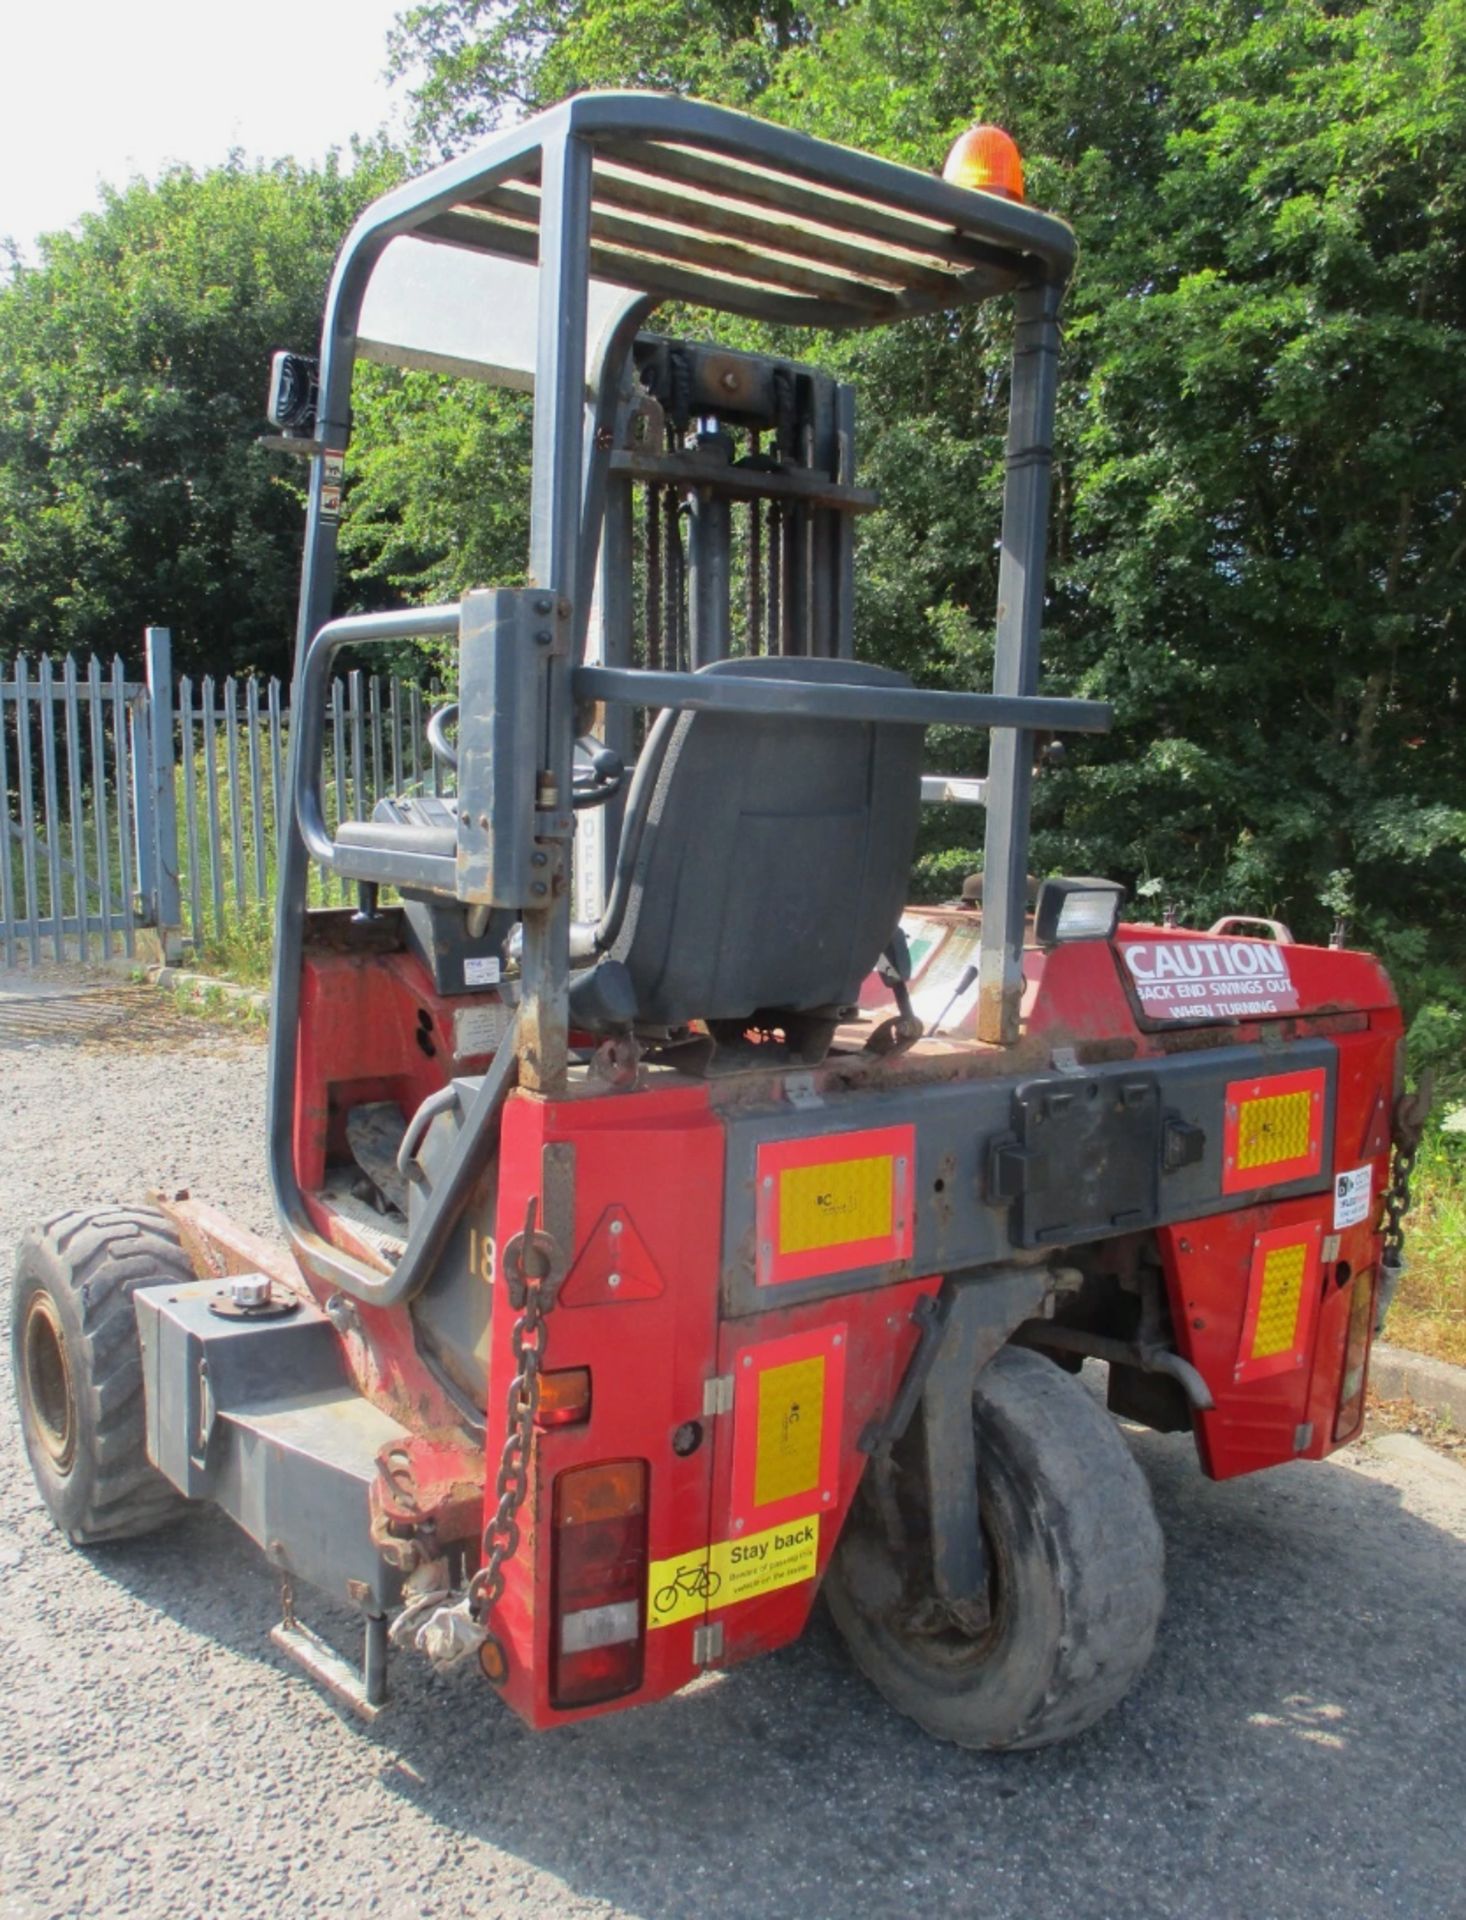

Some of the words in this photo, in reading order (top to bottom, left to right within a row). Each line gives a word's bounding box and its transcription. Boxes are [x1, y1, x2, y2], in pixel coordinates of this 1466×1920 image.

[1125, 943, 1284, 978] CAUTION
[1137, 985, 1174, 1000] BACK
[1176, 983, 1206, 998] END
[1212, 981, 1264, 996] SWINGS
[1266, 979, 1292, 993] OUT
[1168, 1003, 1214, 1018] WHEN
[1216, 999, 1277, 1016] TURNING
[731, 1542, 769, 1564] Stay
[775, 1526, 814, 1550] back
